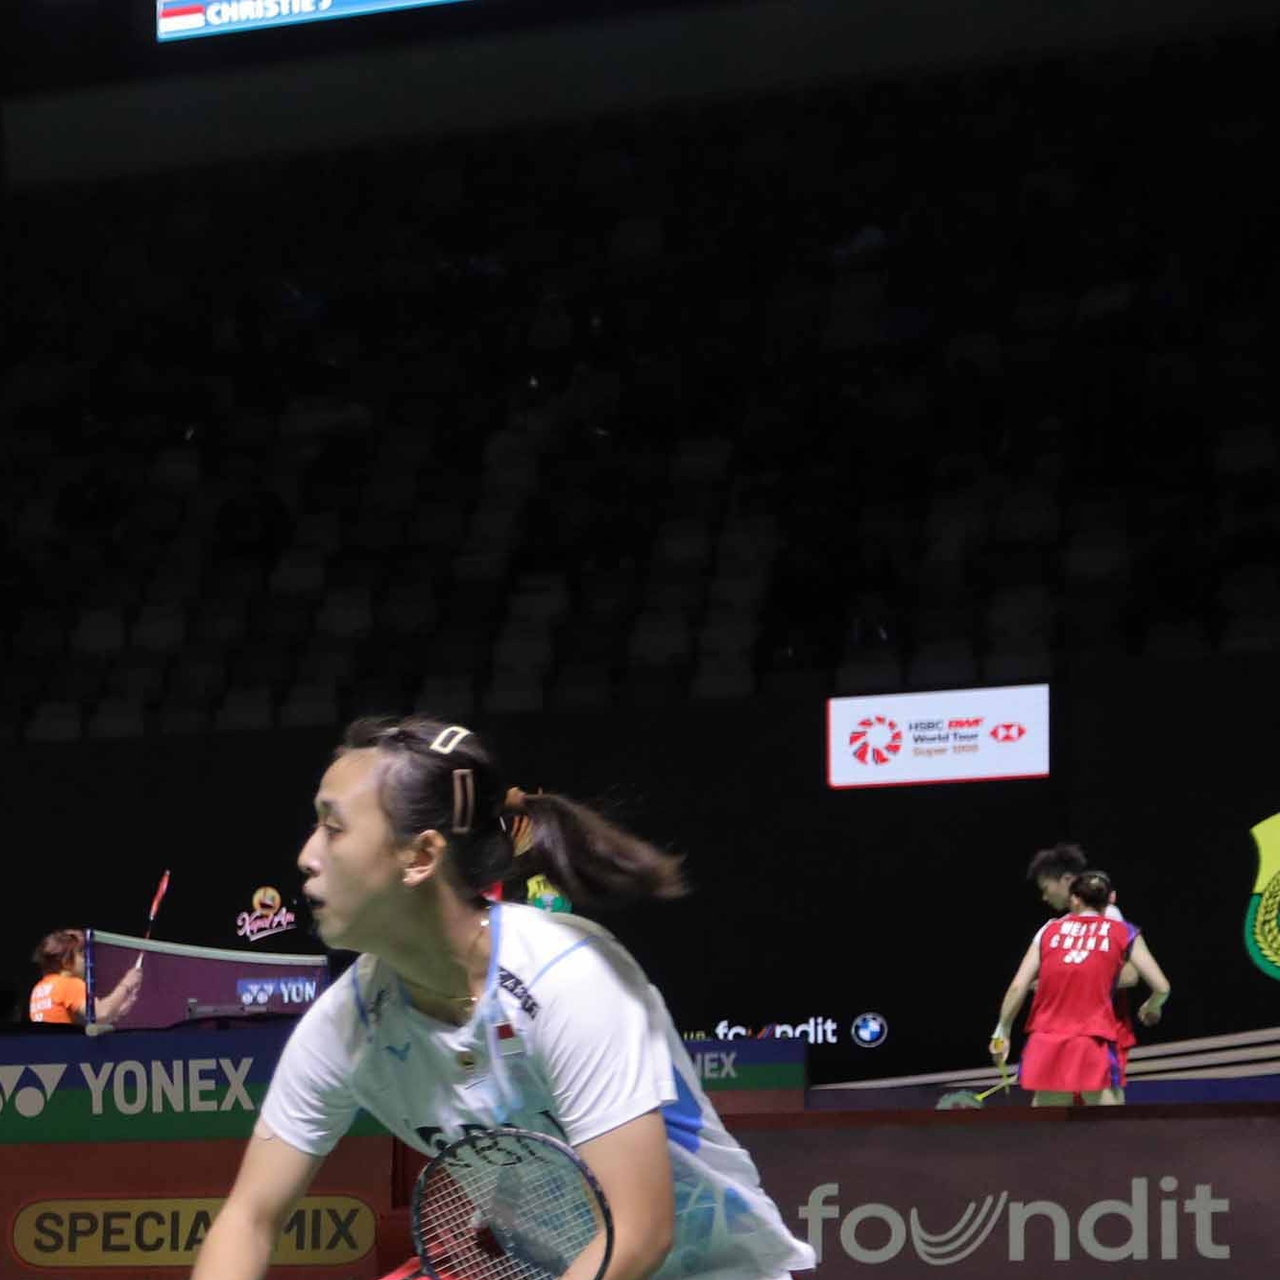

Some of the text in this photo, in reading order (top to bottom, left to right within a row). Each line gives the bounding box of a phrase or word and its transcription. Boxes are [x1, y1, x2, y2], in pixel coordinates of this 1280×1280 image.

[912, 731, 980, 744] World Tour
[280, 981, 317, 1003] YON
[79, 1057, 255, 1115] YONEX
[34, 1210, 212, 1252] SPECIA
[798, 1175, 1231, 1266] foundit
